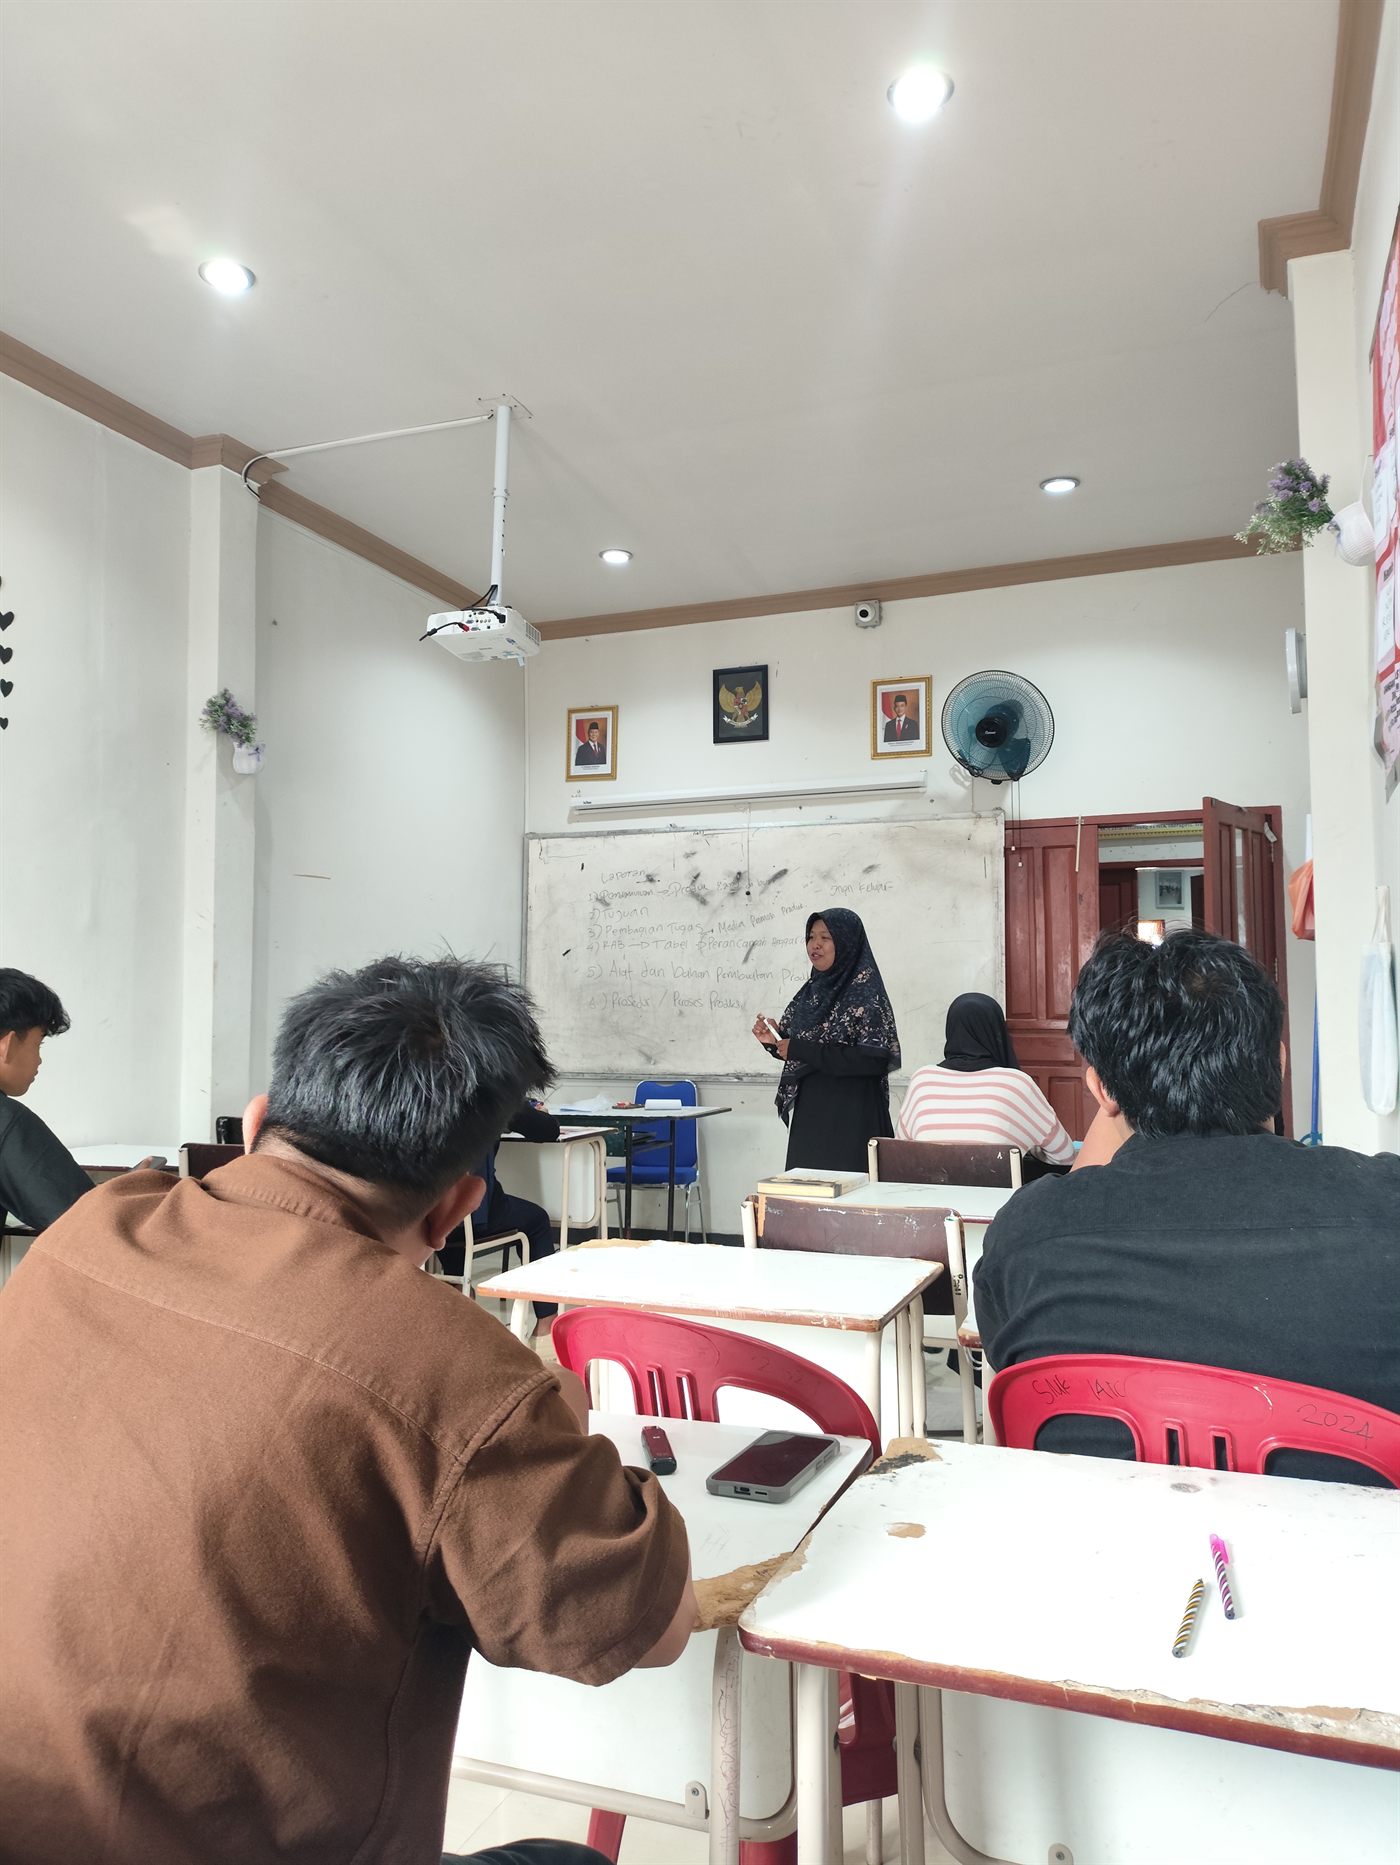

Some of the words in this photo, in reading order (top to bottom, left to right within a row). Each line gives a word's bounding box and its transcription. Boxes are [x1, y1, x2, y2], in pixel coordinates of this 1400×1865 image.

[602, 906, 649, 923] Tujuan
[605, 924, 664, 938] Pembagian
[667, 921, 704, 936] Tugas
[641, 960, 665, 978] dan
[1297, 1402, 1375, 1450] 2024
